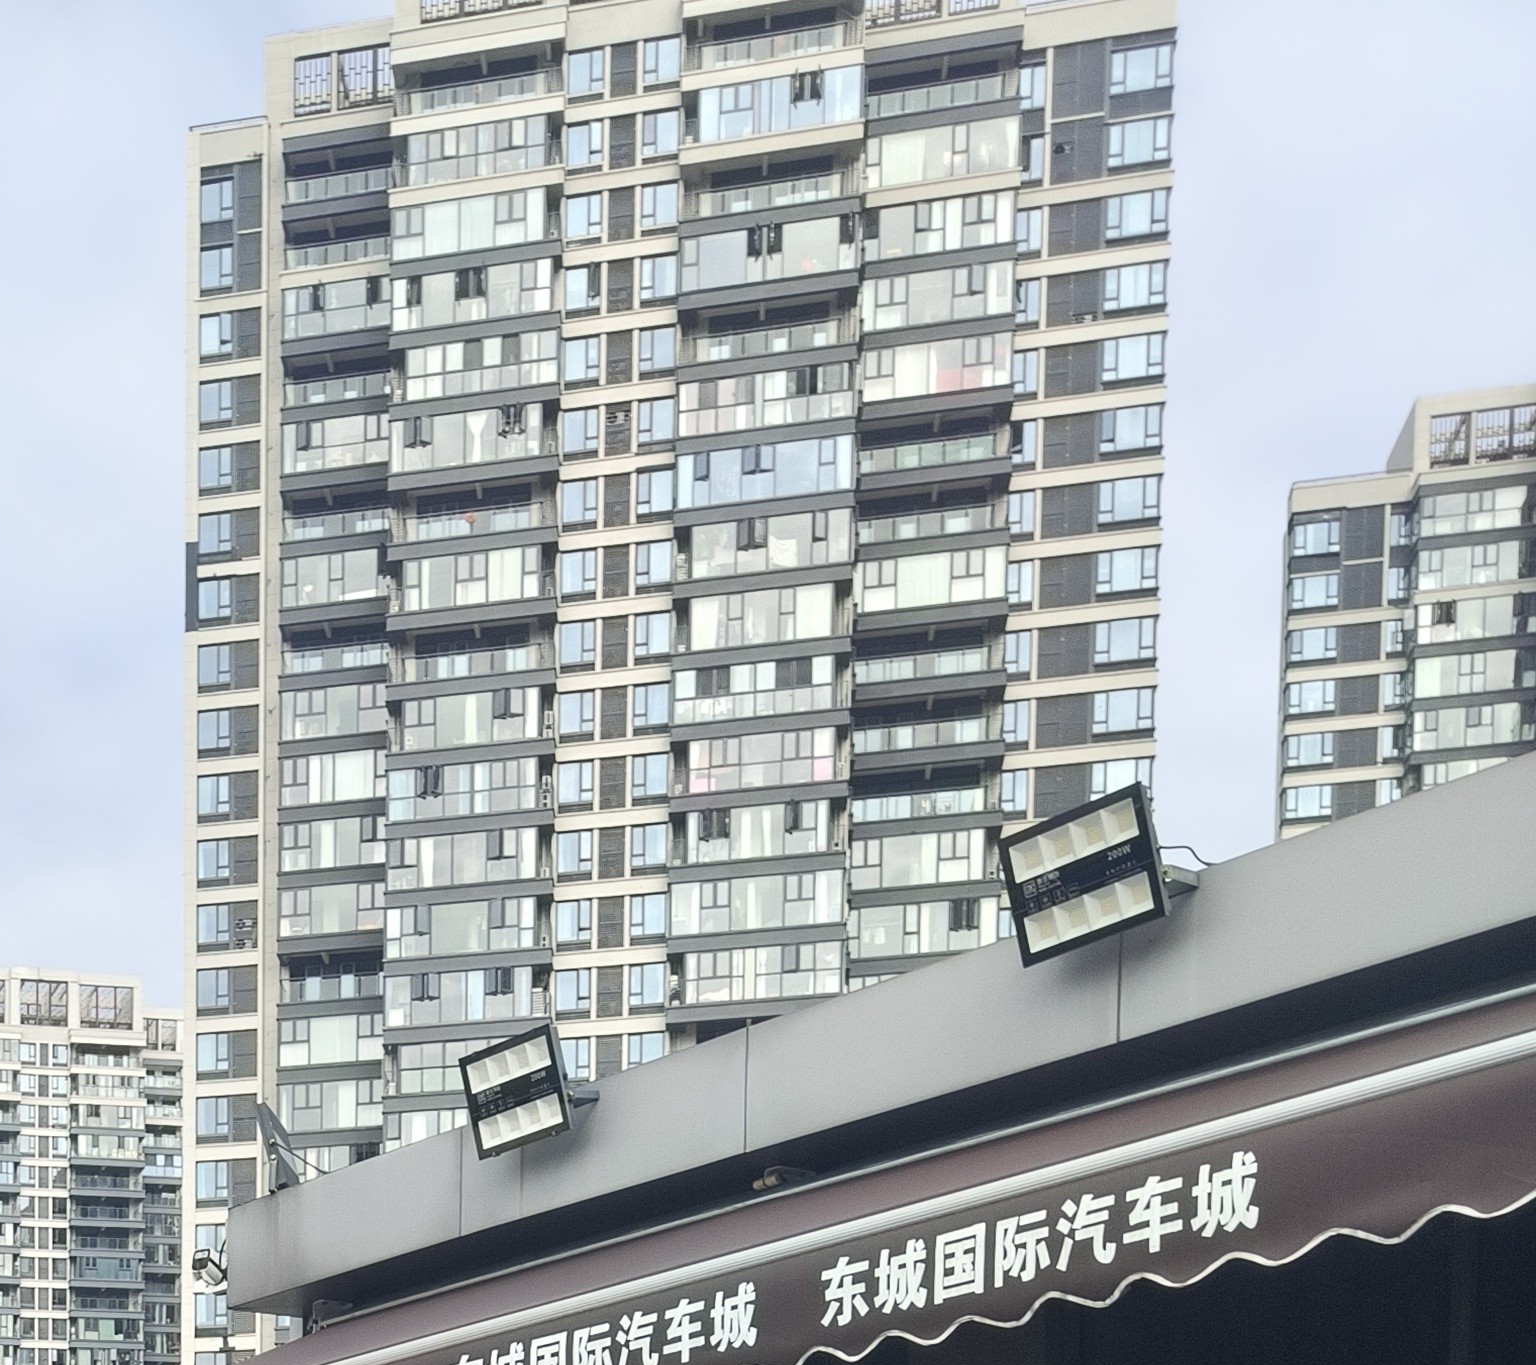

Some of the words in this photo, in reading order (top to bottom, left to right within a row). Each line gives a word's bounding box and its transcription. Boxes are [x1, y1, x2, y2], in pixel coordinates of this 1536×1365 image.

[820, 1151, 1261, 1328] 东城国际汽车城
